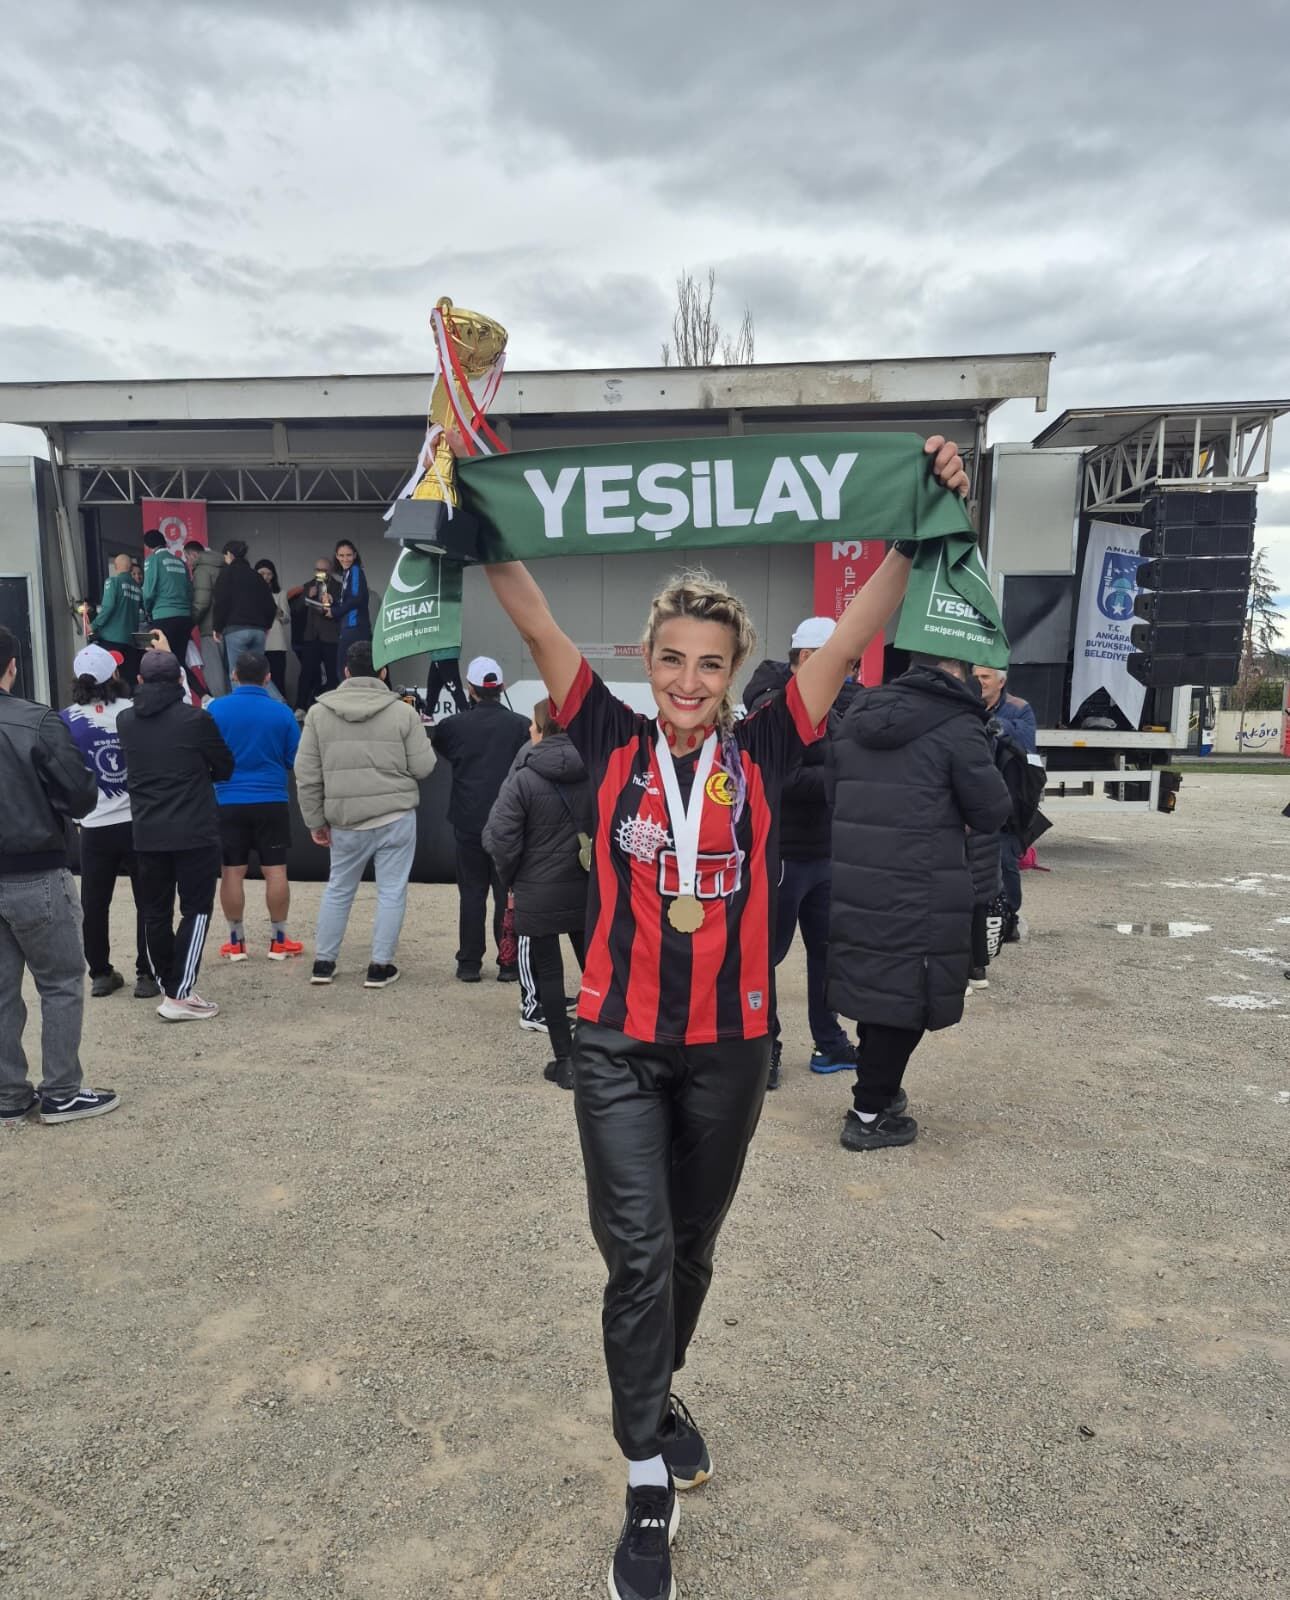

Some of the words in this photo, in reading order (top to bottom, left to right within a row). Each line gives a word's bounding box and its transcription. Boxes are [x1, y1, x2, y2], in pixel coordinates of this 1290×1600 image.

[523, 452, 859, 541] YEŞİLAY
[386, 600, 434, 623] YEŞİLAY
[1096, 631, 1131, 642] ANKARA
